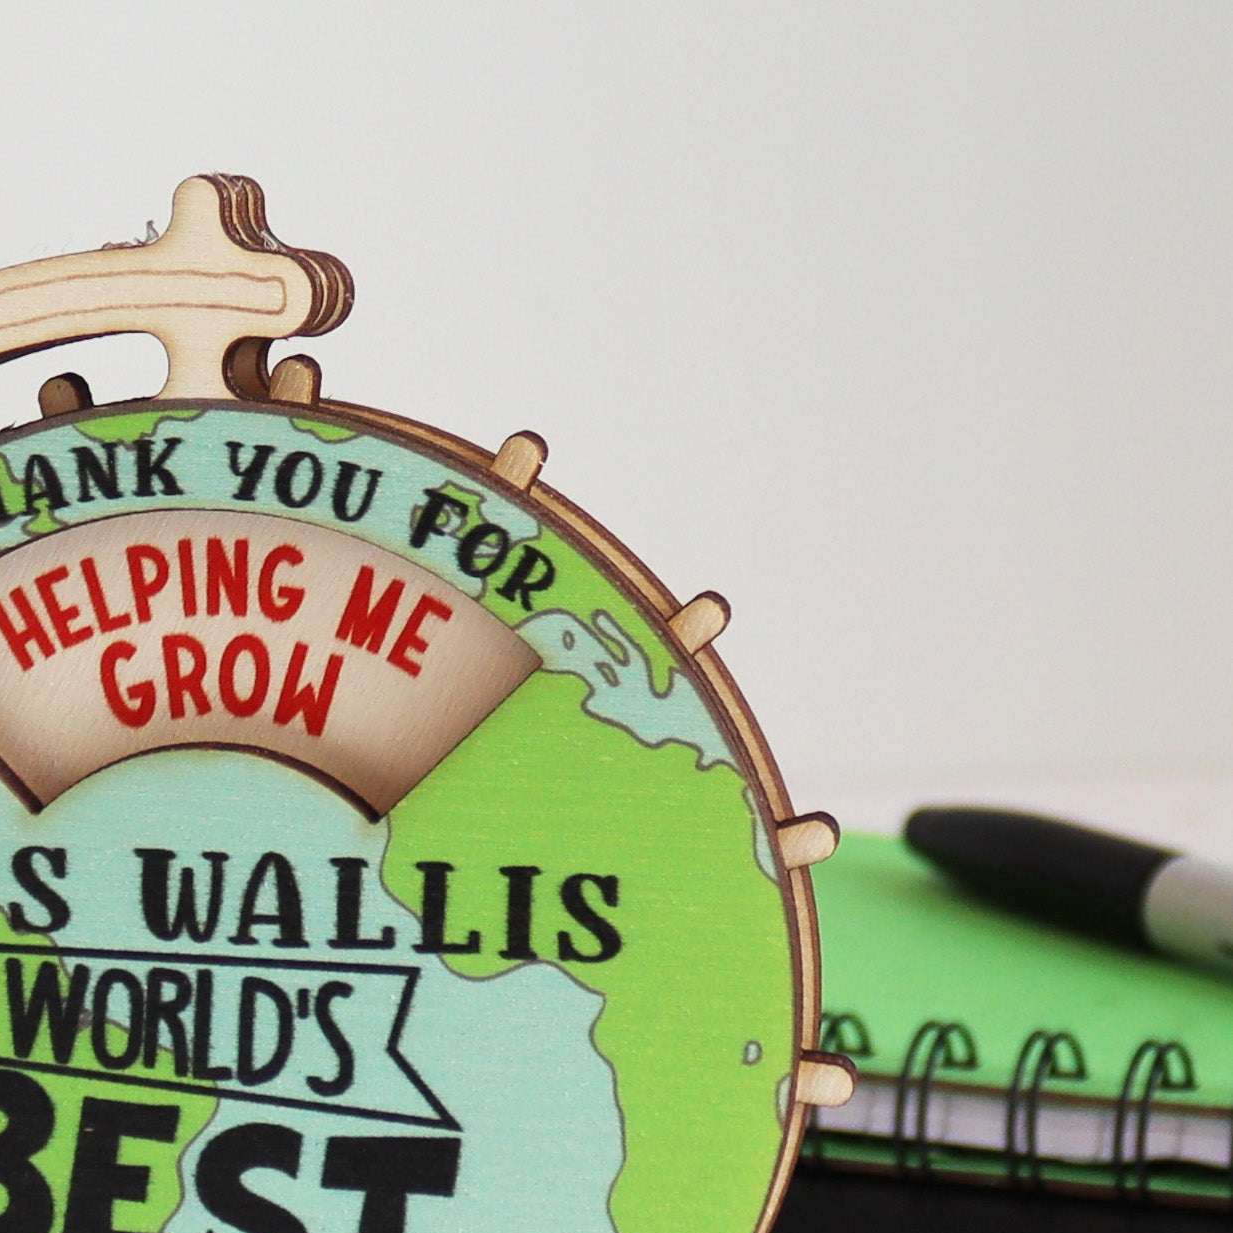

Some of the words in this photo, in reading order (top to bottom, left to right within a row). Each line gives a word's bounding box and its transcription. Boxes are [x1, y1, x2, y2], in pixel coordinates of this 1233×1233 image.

[228, 440, 383, 523] YOU
[410, 486, 557, 612] FOR
[335, 565, 453, 678] ME
[100, 632, 343, 738] GROW
[136, 847, 623, 962] WALLIS
[6, 957, 354, 1097] WORLD'S
